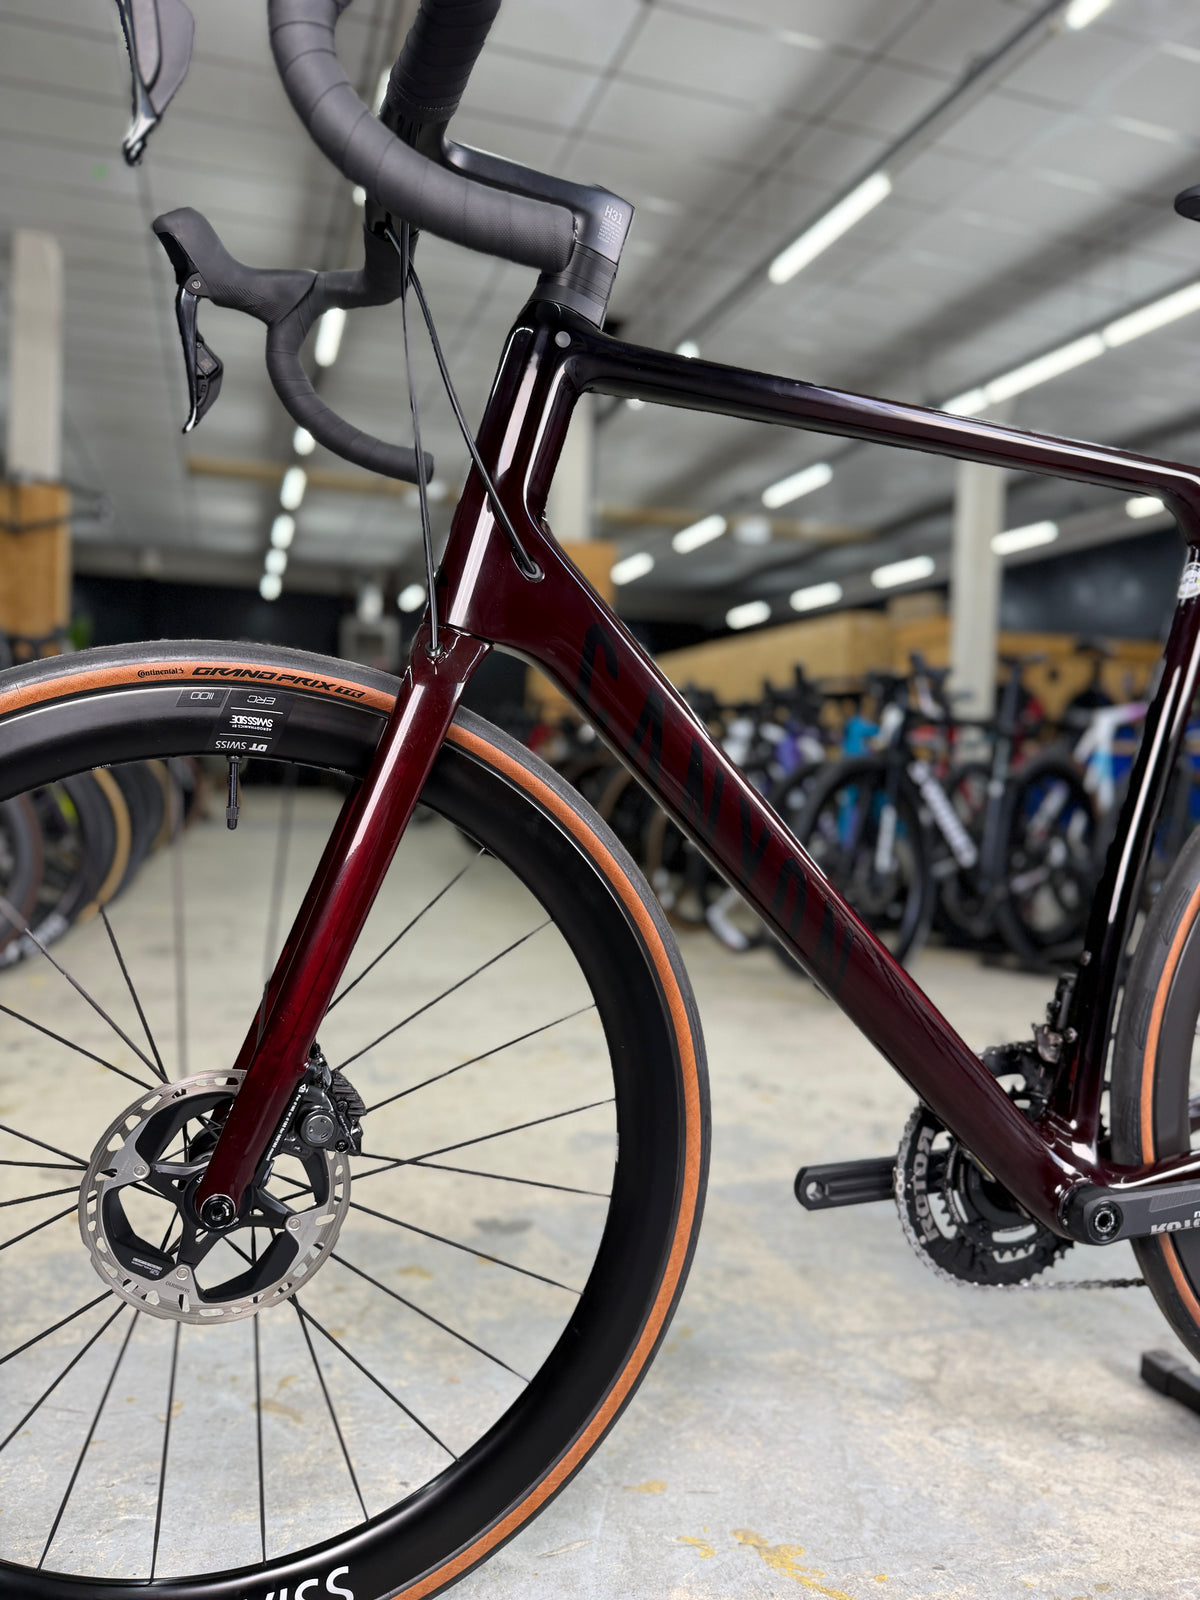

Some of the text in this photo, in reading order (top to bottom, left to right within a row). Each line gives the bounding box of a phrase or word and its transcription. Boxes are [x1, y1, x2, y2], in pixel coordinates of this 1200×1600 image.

[604, 205, 622, 225] H31
[191, 667, 276, 681] GRAND
[276, 674, 336, 691] PRIX
[246, 694, 277, 706] ERC
[215, 740, 268, 752] DT SWISS
[575, 622, 853, 996] CANYON
